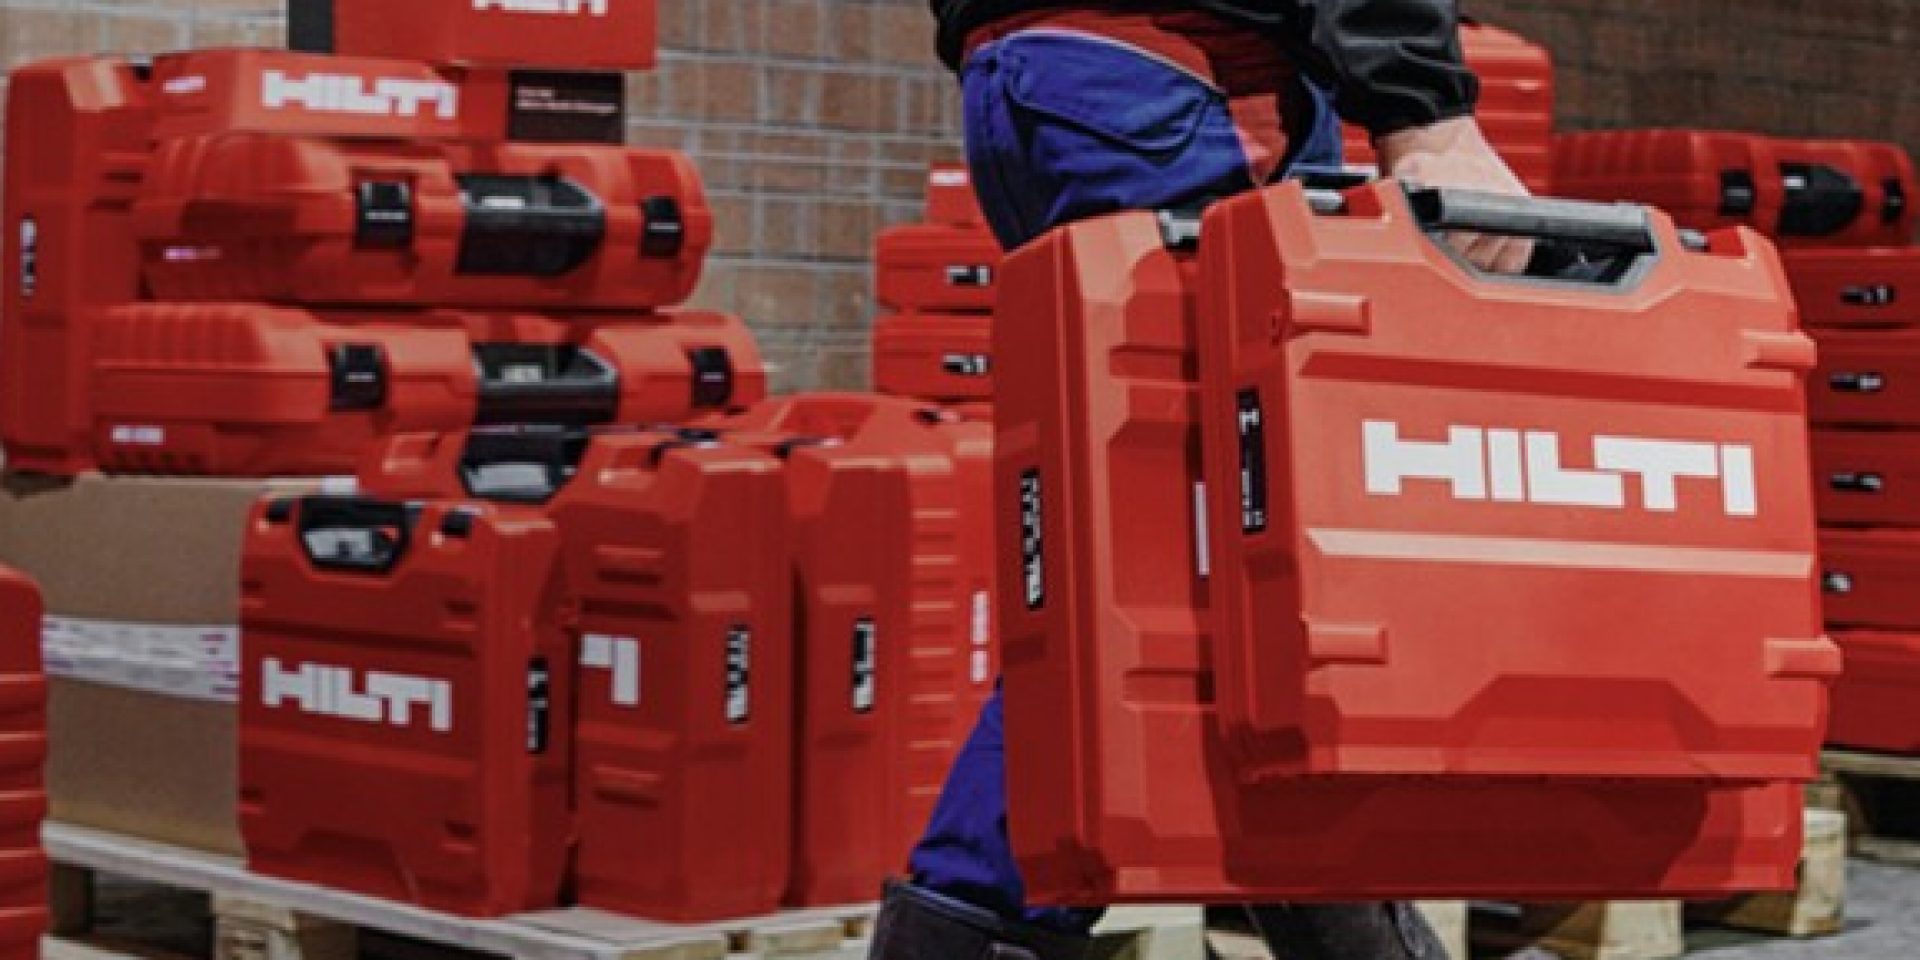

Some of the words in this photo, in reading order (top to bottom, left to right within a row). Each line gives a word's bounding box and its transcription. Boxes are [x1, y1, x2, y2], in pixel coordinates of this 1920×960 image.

[262, 69, 457, 118] HILTI
[1362, 420, 1757, 516] HILTI
[262, 657, 452, 732] HILTI
